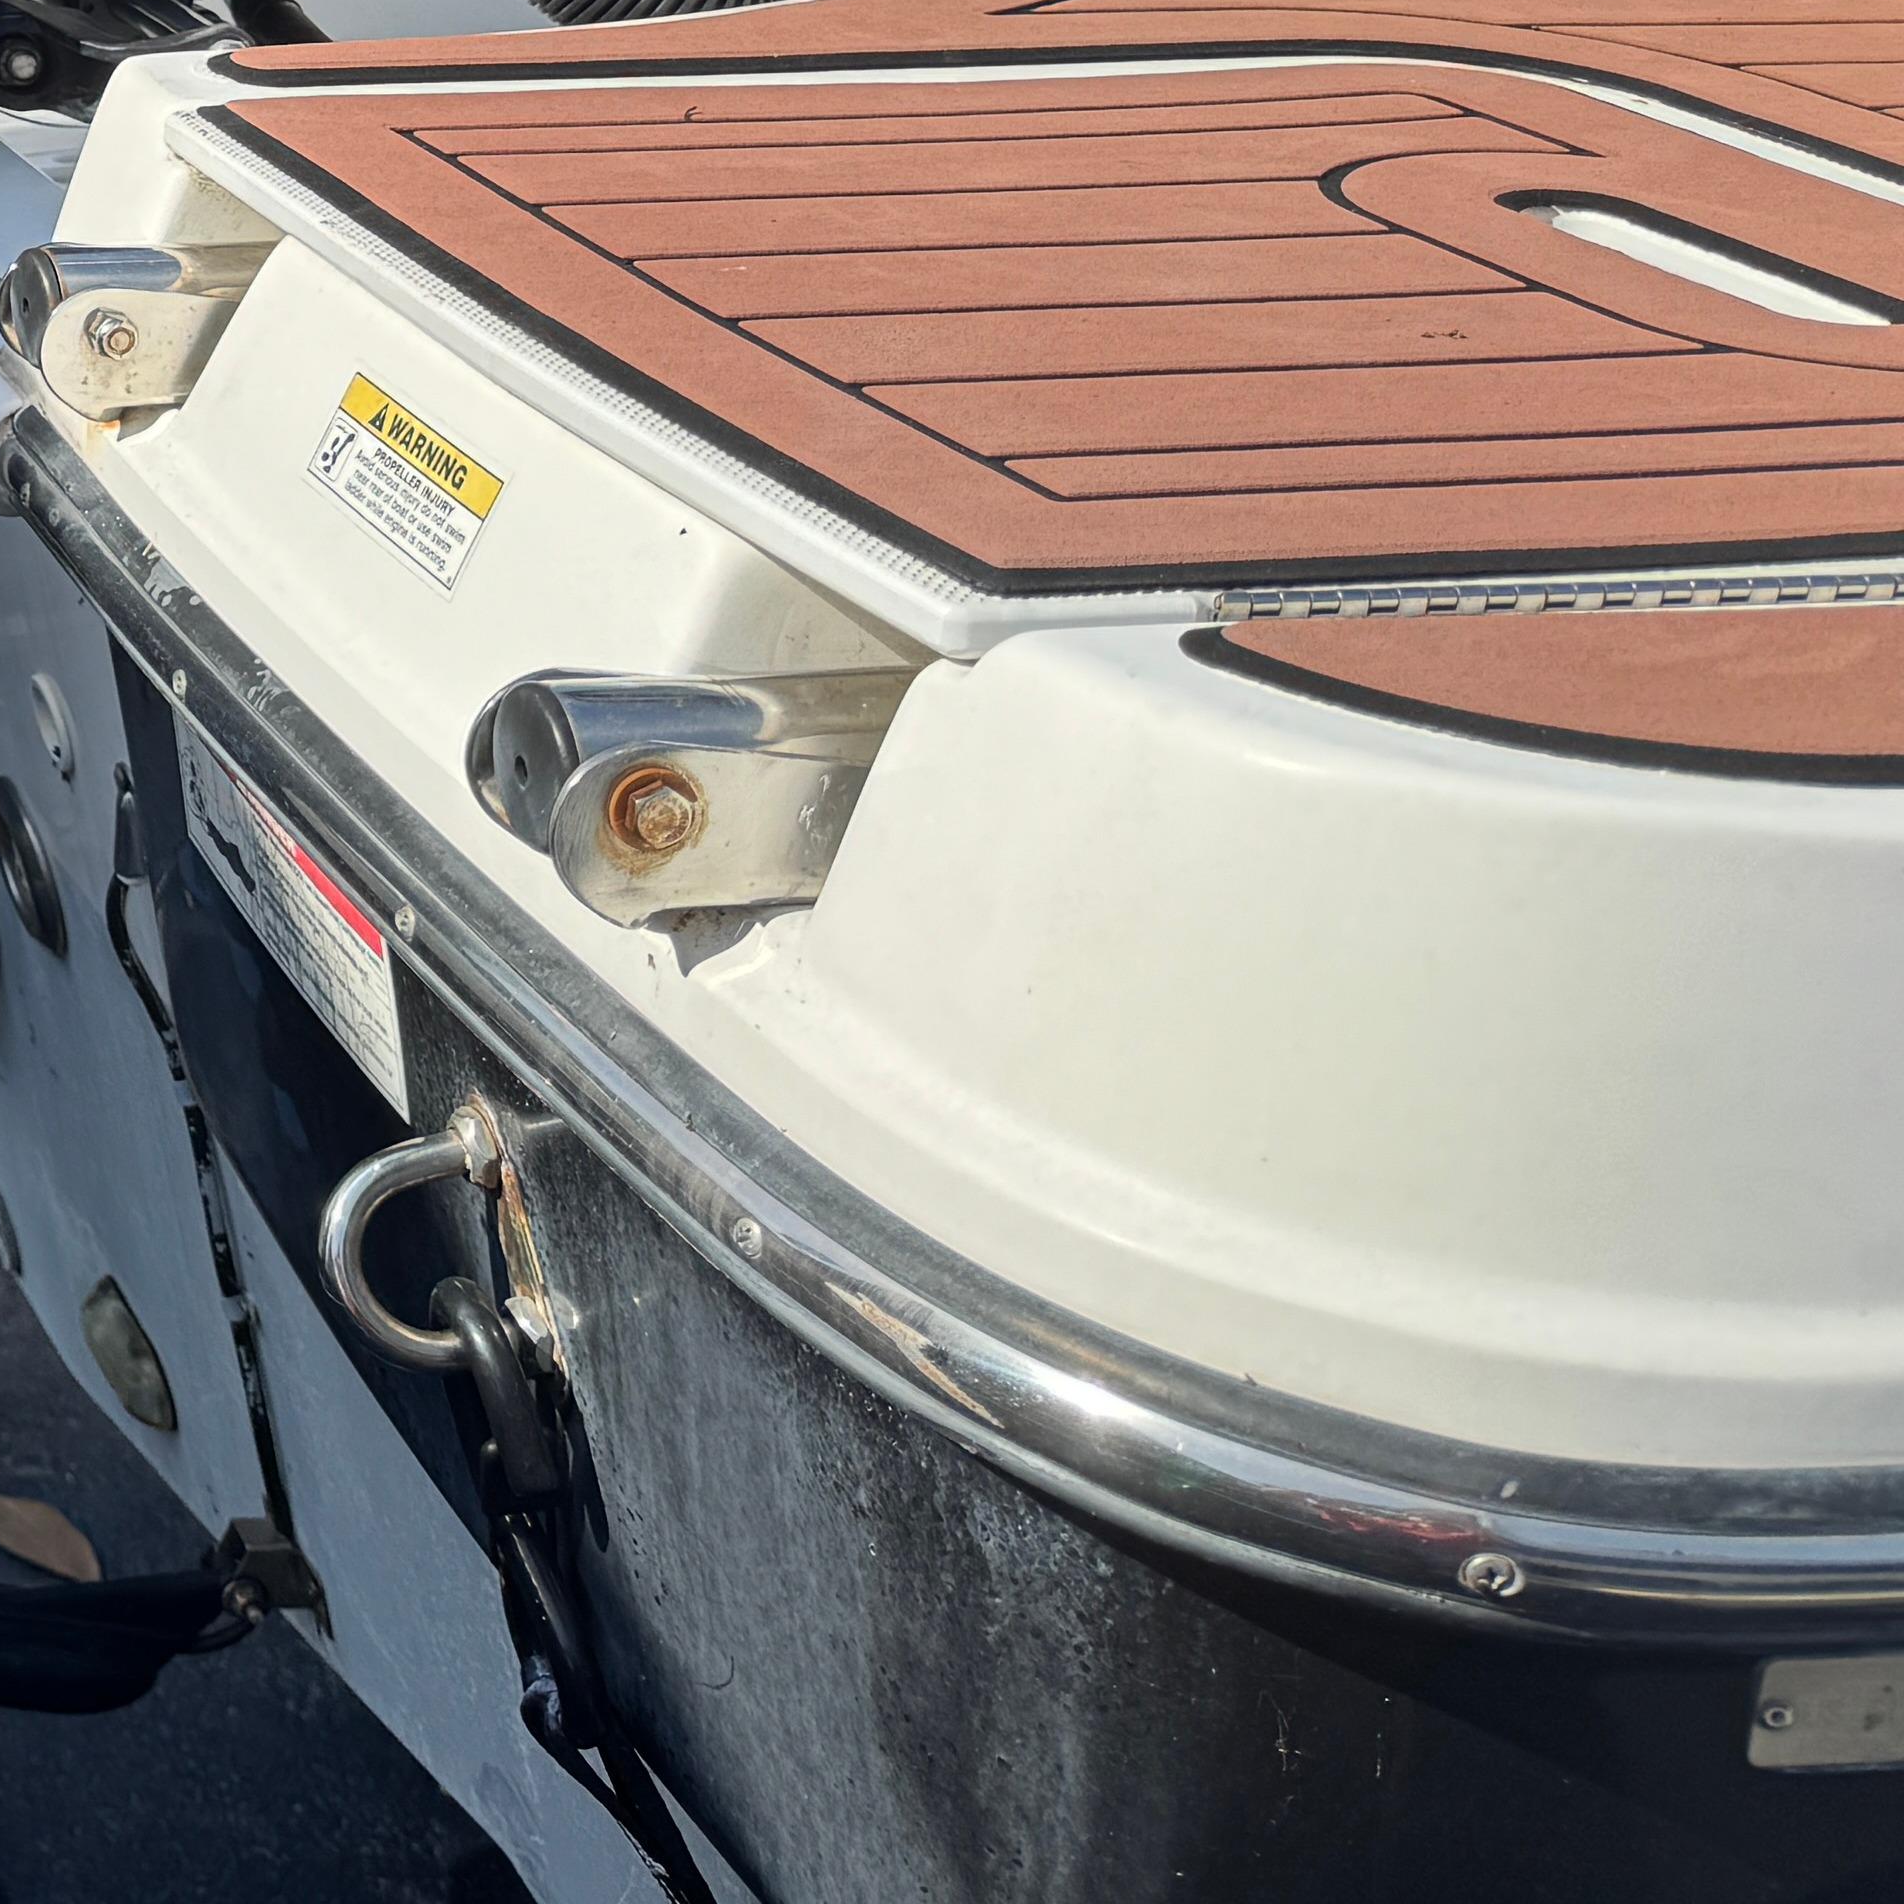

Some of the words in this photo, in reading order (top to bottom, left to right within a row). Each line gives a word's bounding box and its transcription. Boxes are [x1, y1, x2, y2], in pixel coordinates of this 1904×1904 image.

[373, 447, 422, 492] PROPELLER
[420, 485, 455, 517] INJURY
[388, 413, 468, 491] WARNING
